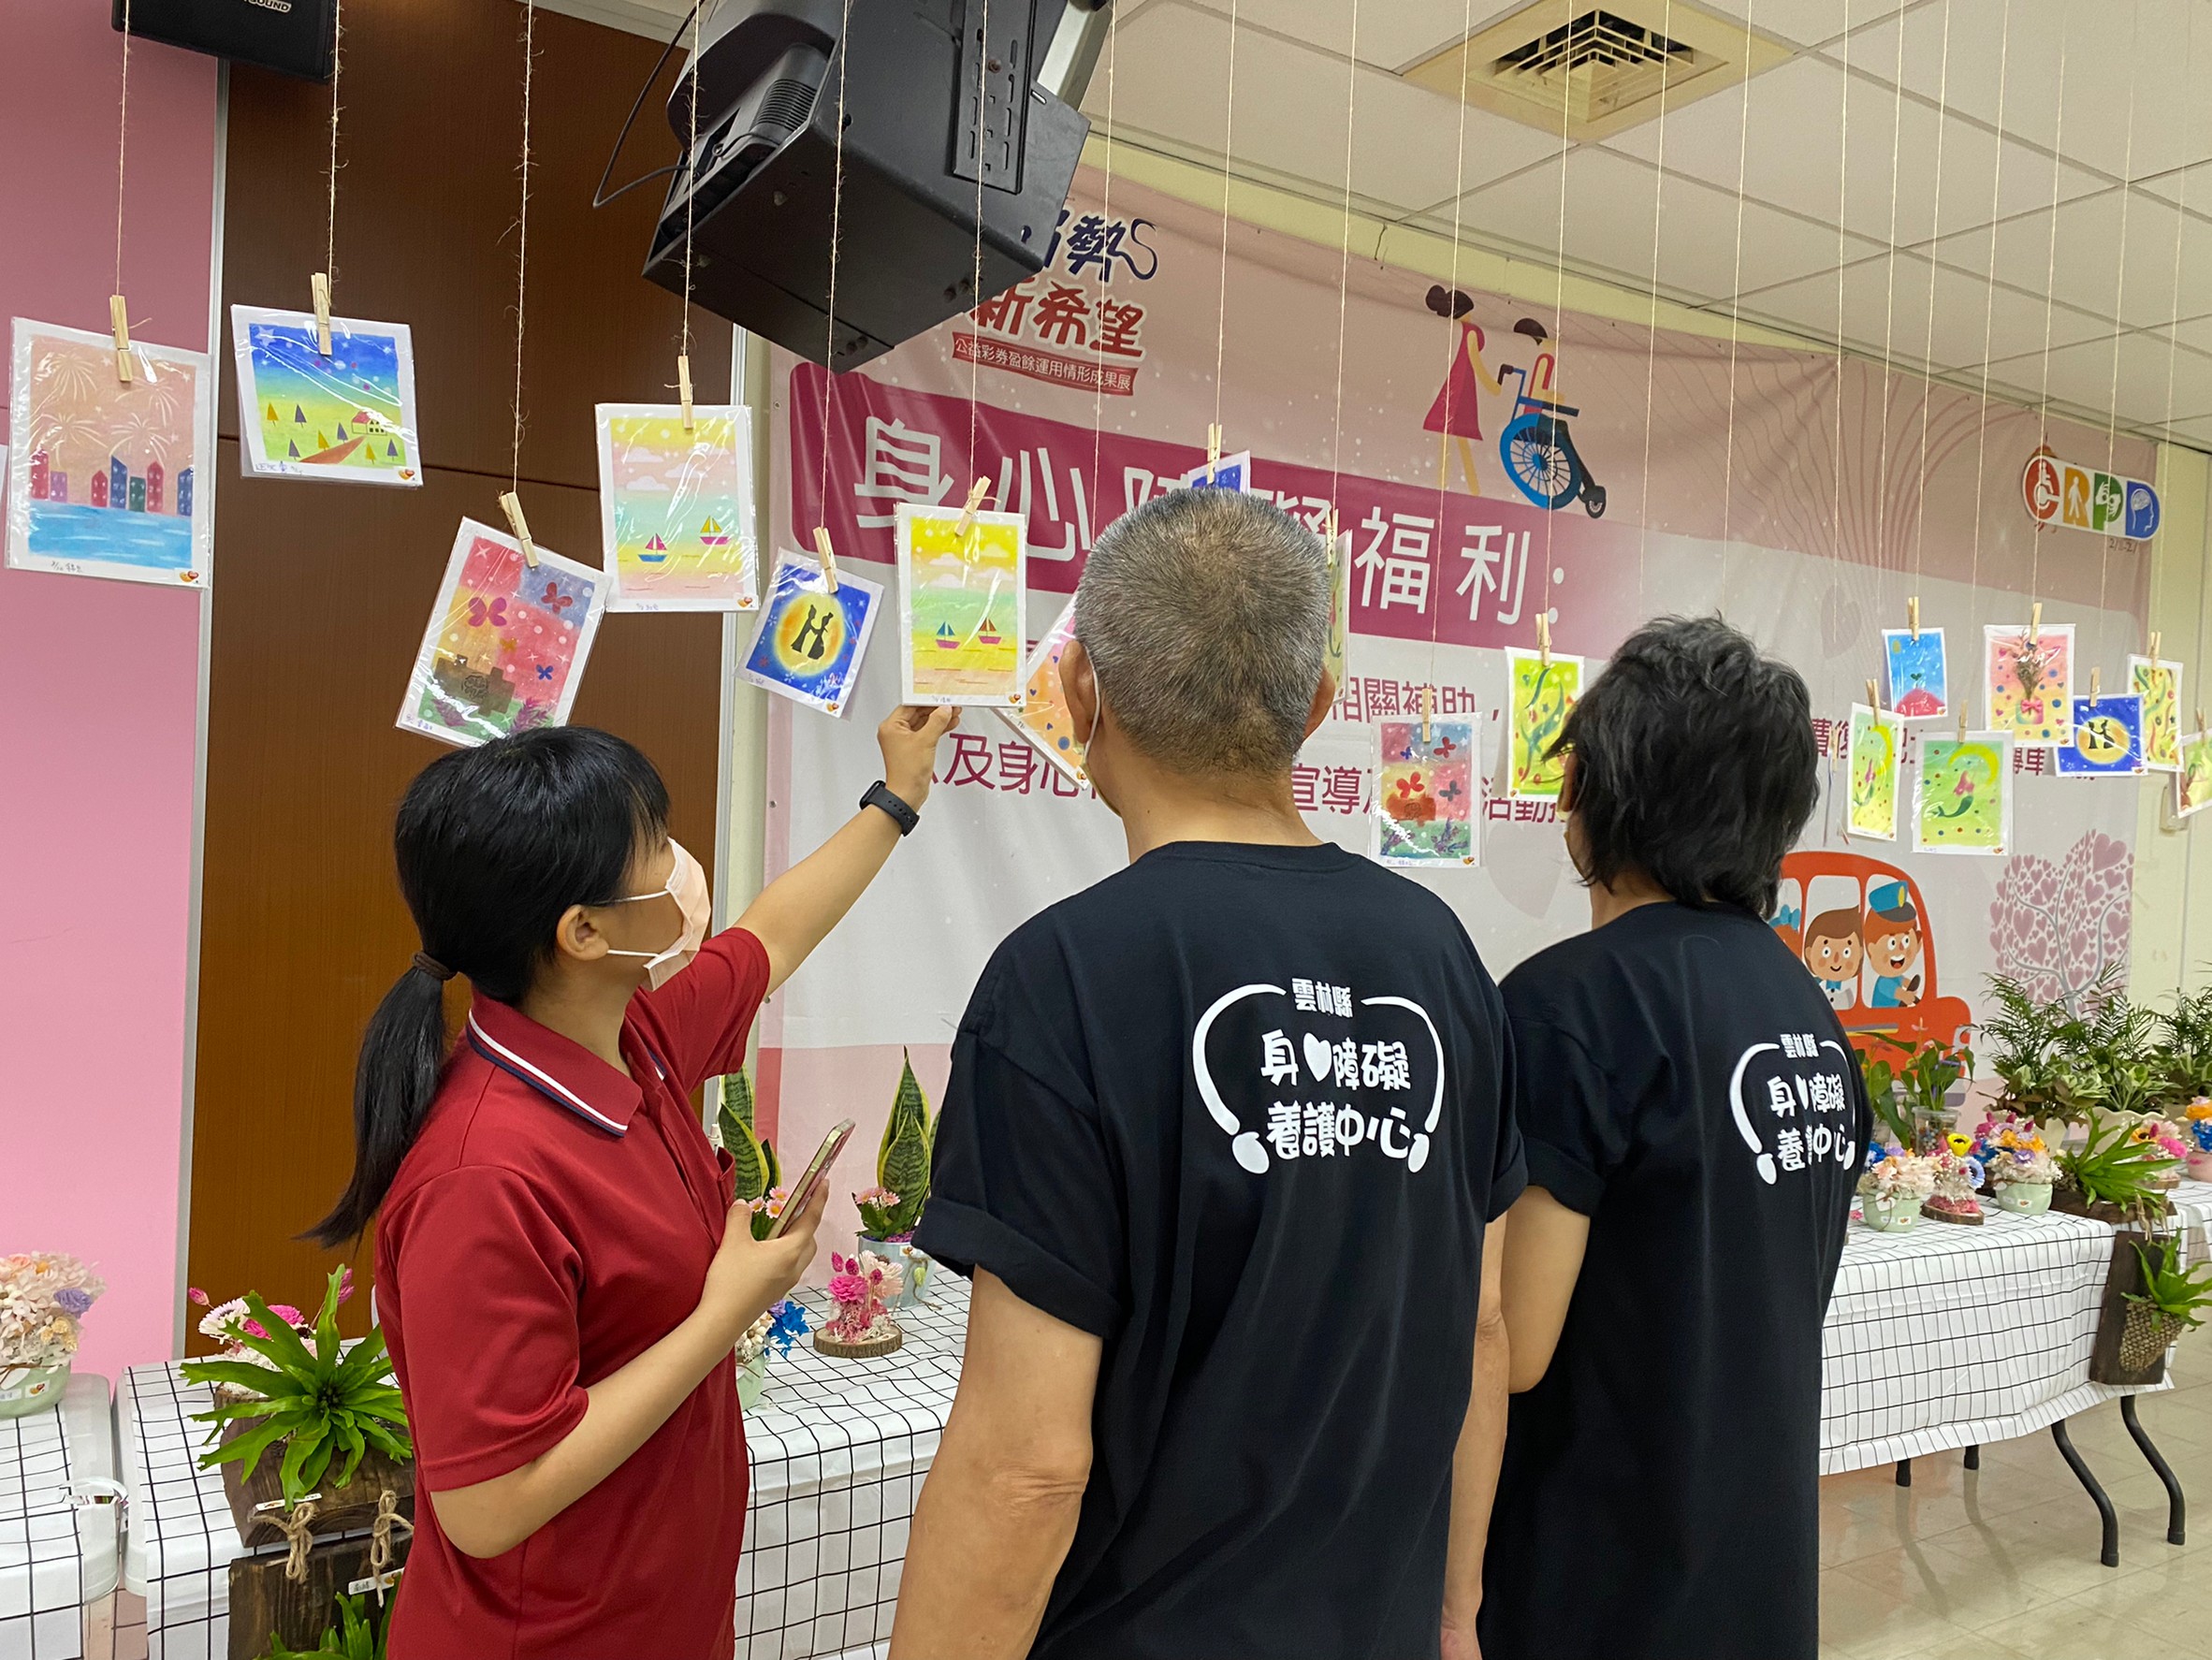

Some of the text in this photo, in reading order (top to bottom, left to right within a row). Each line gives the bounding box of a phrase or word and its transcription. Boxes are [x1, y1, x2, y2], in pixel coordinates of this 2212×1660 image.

[2025, 459, 2161, 540] CRPD
[1291, 978, 1353, 1018] 雲林縣
[1266, 1099, 1411, 1159] 養護中心
[1777, 1123, 1846, 1172] 養中心
